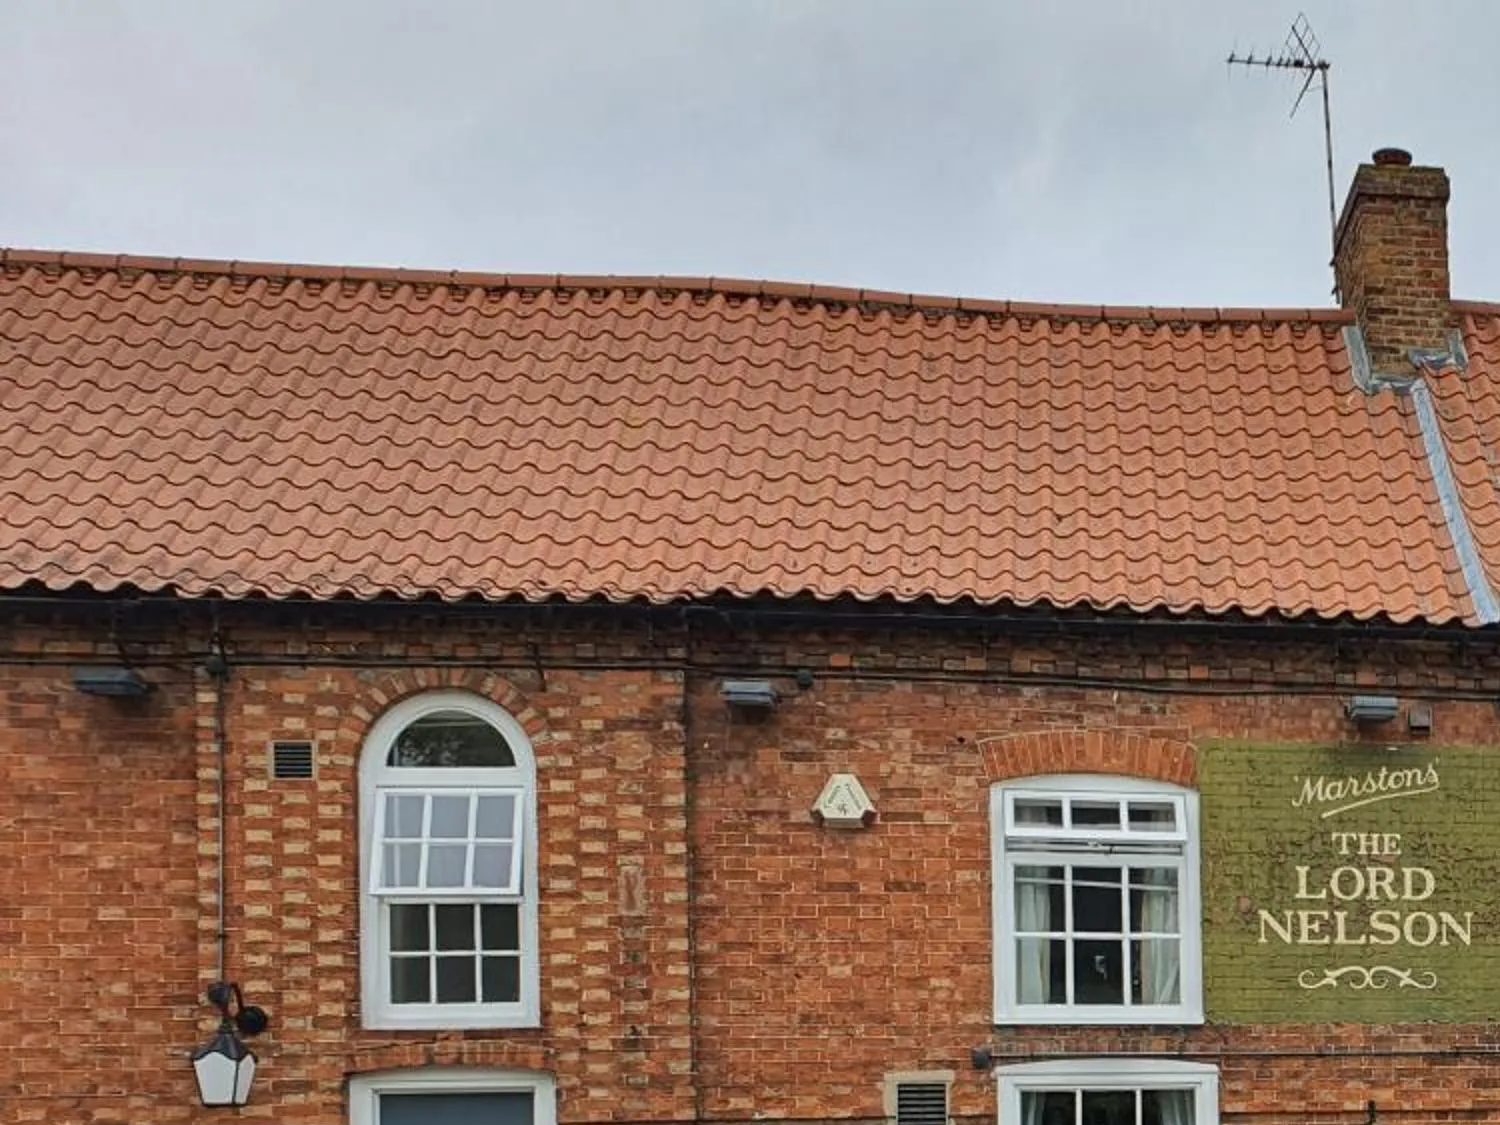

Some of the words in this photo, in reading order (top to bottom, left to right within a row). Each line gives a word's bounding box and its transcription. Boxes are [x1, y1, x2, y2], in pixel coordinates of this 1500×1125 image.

[1332, 832, 1402, 855] THE
[1295, 866, 1436, 901] LORD
[1257, 909, 1474, 947] NELSON
